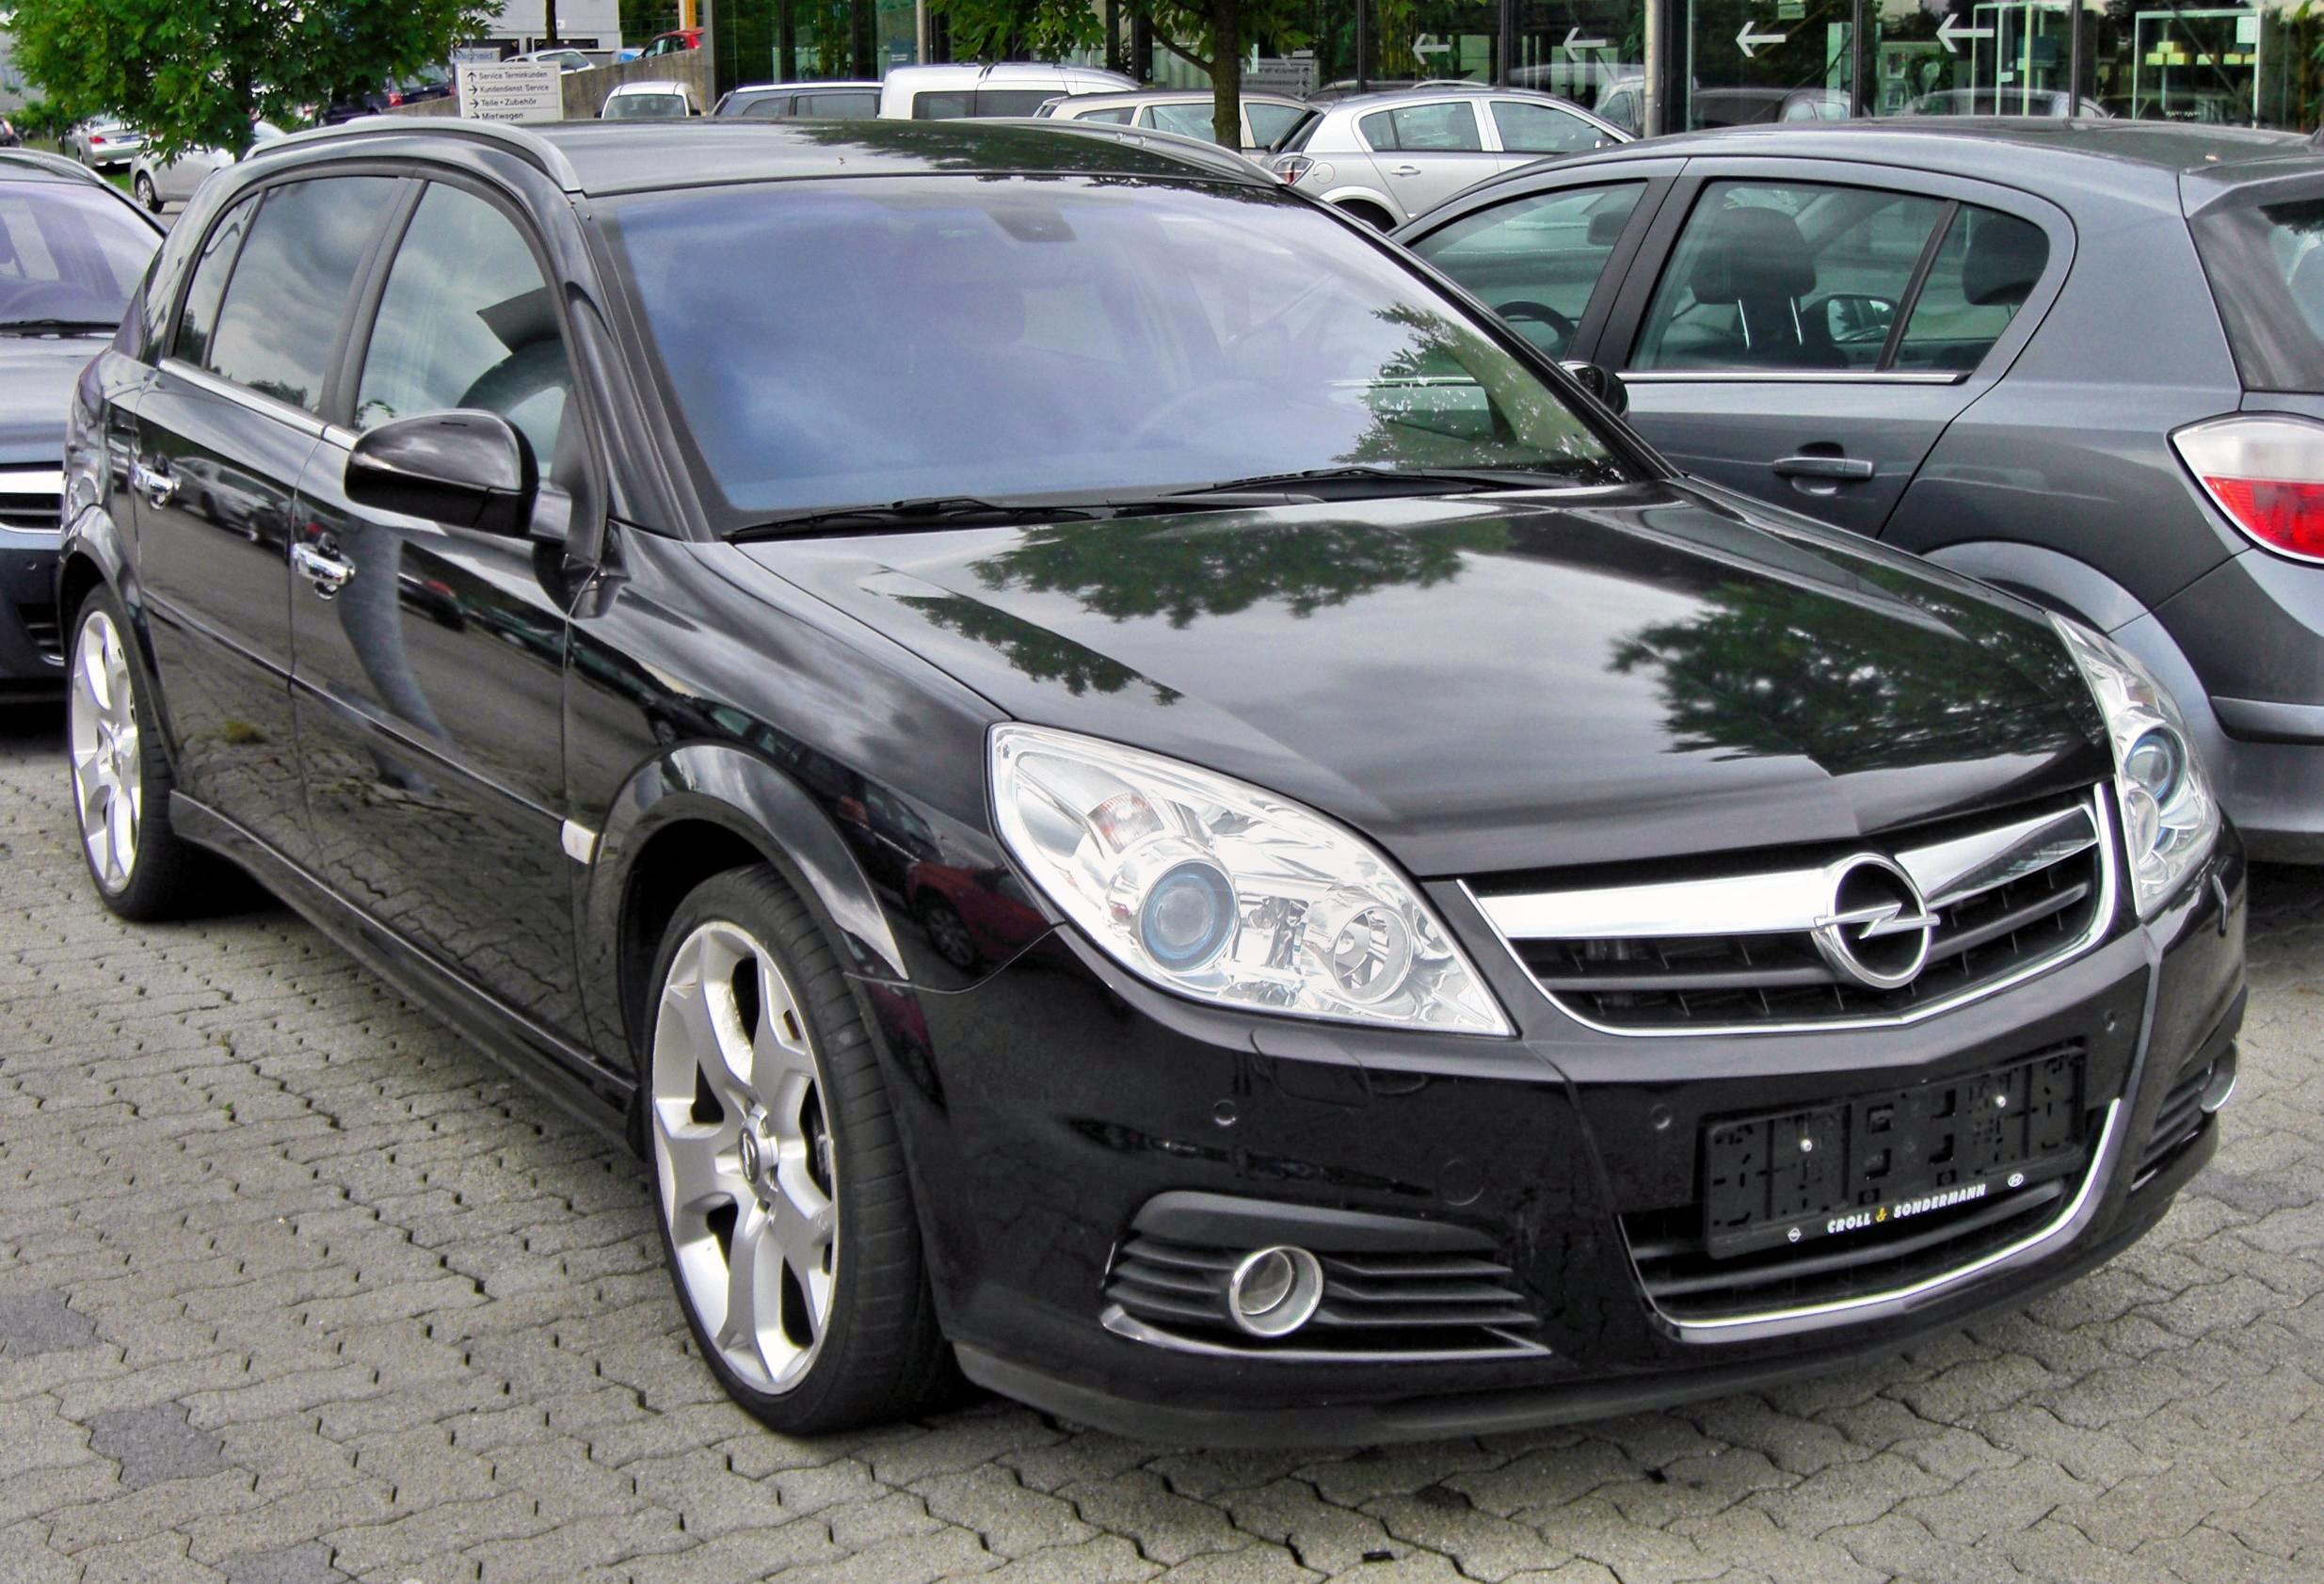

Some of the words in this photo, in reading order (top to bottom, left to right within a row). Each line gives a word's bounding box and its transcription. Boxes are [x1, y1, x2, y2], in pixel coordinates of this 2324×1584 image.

[505, 97, 537, 106] Zubehör
[482, 113, 524, 121] Mietwagen
[1827, 1212, 1871, 1234] CROLL
[1876, 1207, 1888, 1224] &
[1893, 1183, 1986, 1219] SONDERMANN
